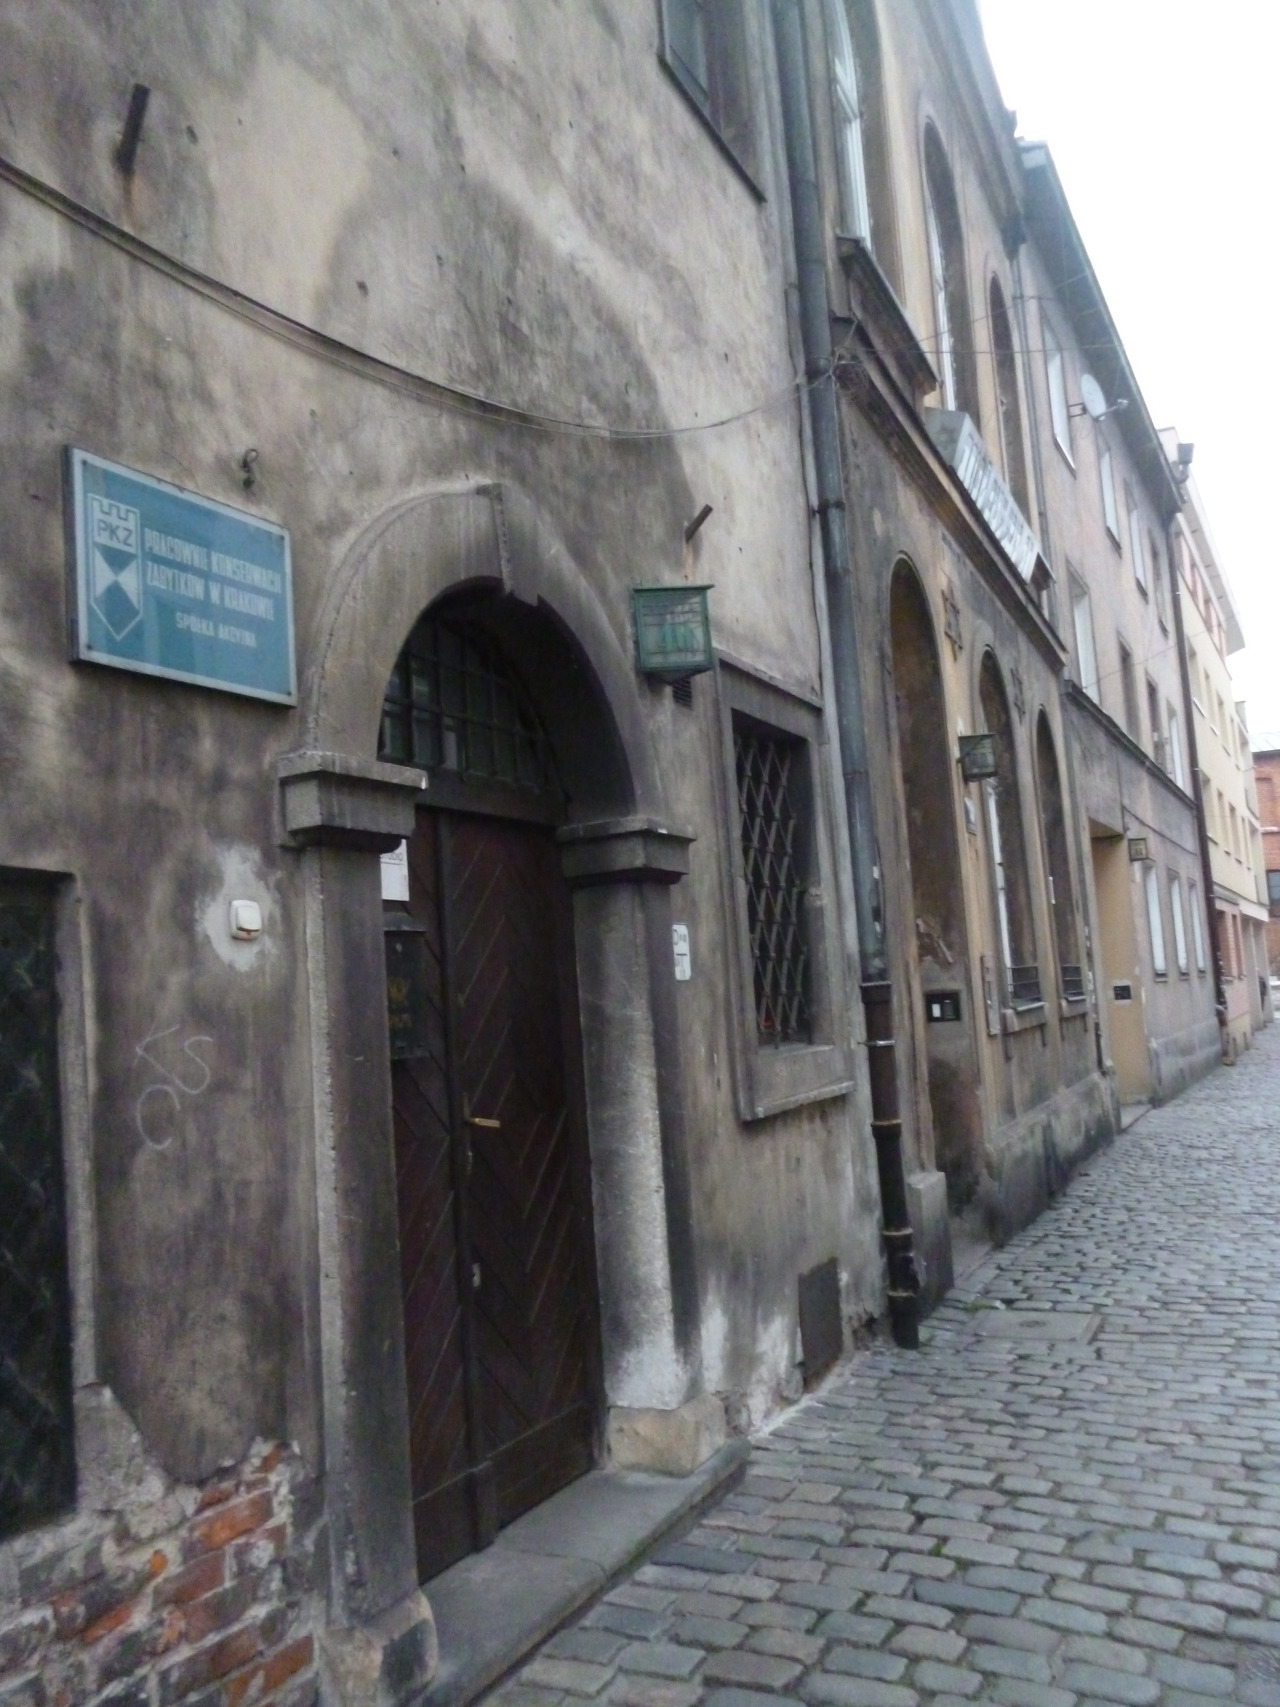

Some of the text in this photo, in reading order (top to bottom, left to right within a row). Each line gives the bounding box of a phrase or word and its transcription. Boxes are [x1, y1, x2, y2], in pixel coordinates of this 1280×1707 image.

[97, 518, 134, 547] PKZ
[144, 527, 281, 594] PRACOWNIE KONSERWACJI
[208, 580, 220, 605] W
[224, 585, 274, 621] KRAKOWIE
